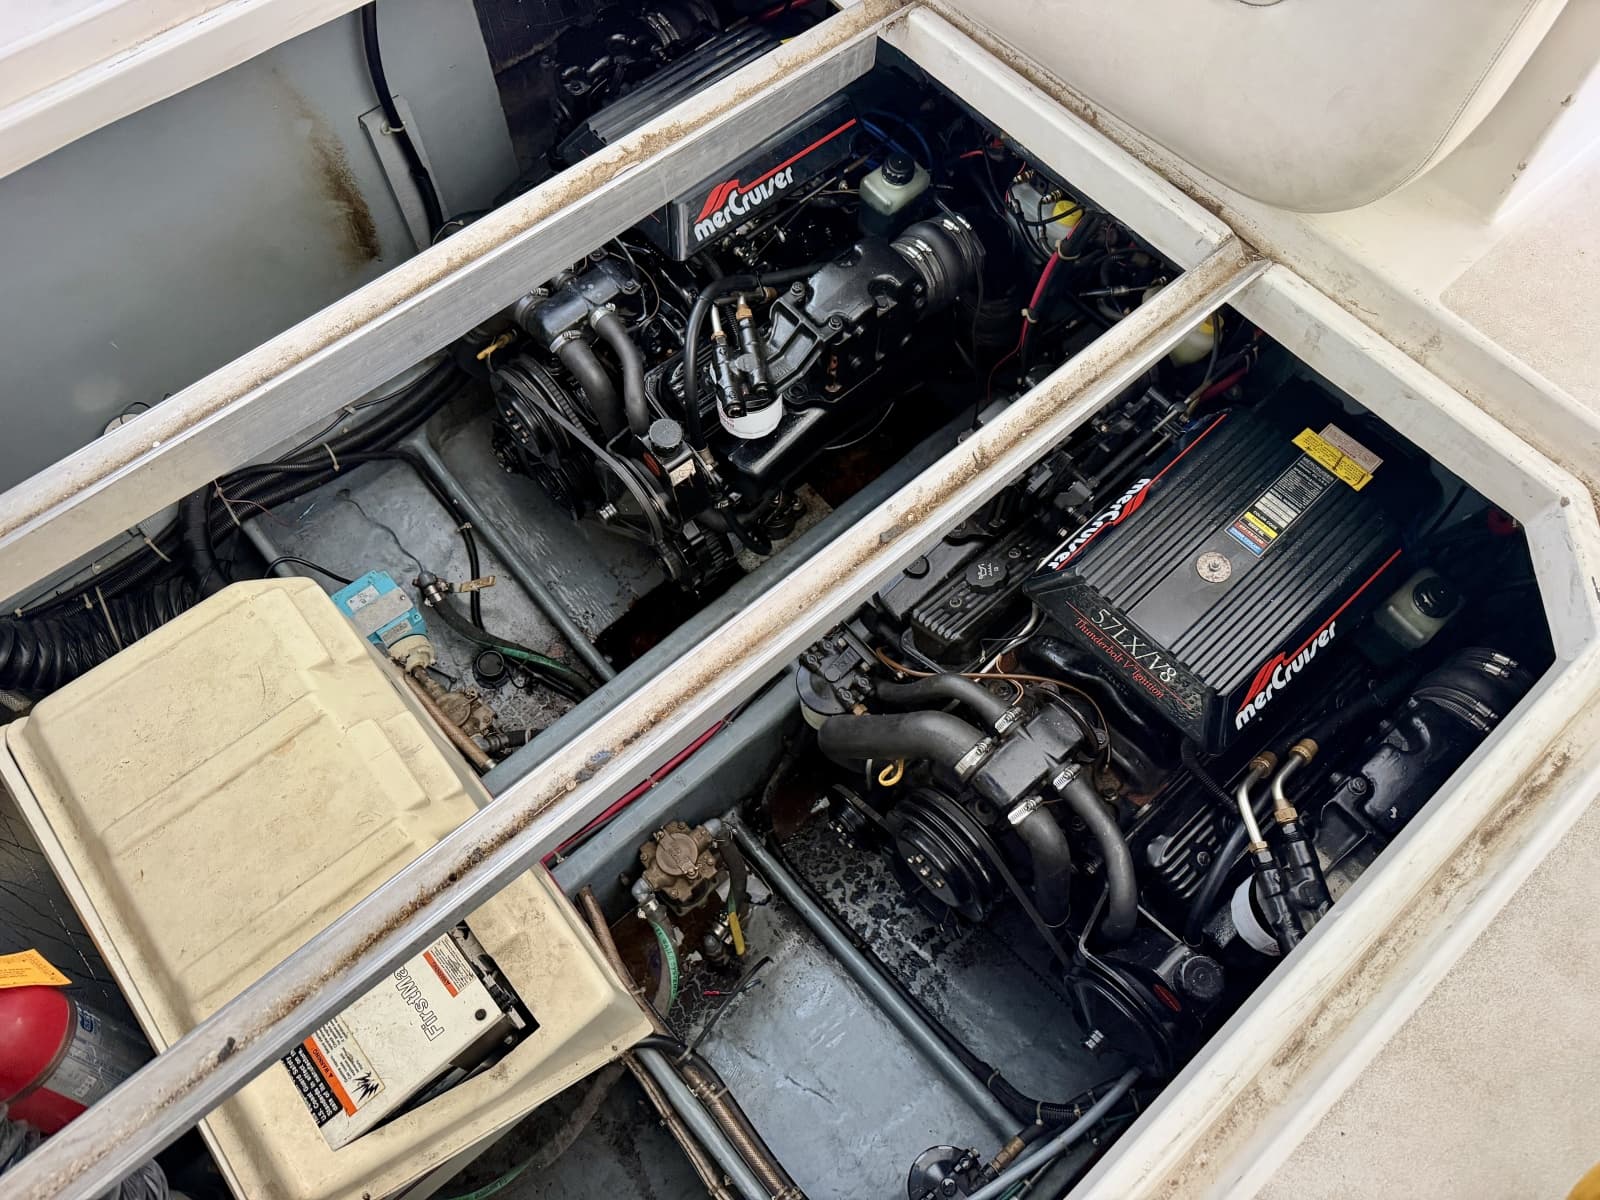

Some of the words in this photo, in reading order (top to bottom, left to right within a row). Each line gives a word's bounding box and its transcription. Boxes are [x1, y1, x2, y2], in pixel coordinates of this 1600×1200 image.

[1074, 617, 1123, 663] Thunderbolt
[1131, 668, 1165, 699] Ignition
[284, 1056, 299, 1075] Safety
[293, 1056, 301, 1064] on
[297, 1063, 312, 1081] effect
[295, 1074, 309, 1092] Guard
[306, 1091, 320, 1109] Coast
[312, 1087, 333, 1116] Standards
